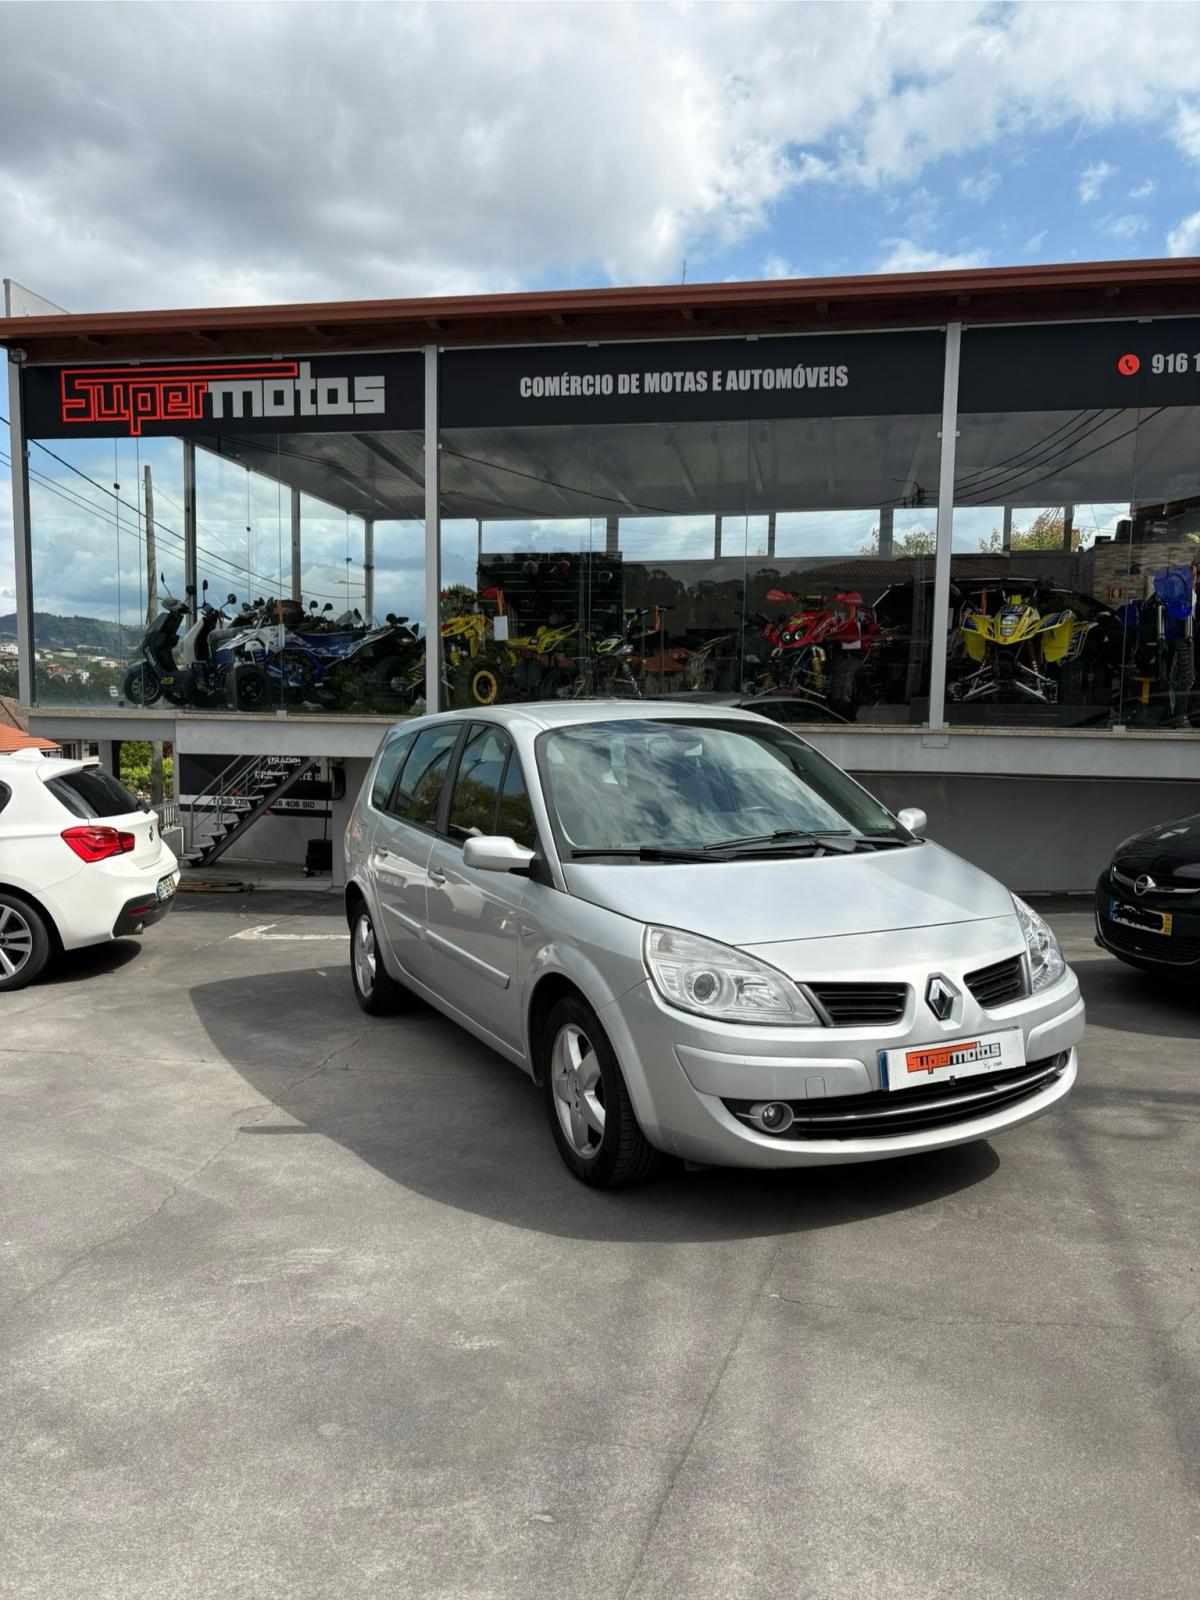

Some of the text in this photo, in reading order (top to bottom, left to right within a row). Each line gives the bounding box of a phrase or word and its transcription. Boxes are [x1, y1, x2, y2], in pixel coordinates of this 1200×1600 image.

[1152, 353, 1188, 374] 916
[520, 363, 849, 398] COMÉRCIO DE MOTAS E AUTOMÓVEIS
